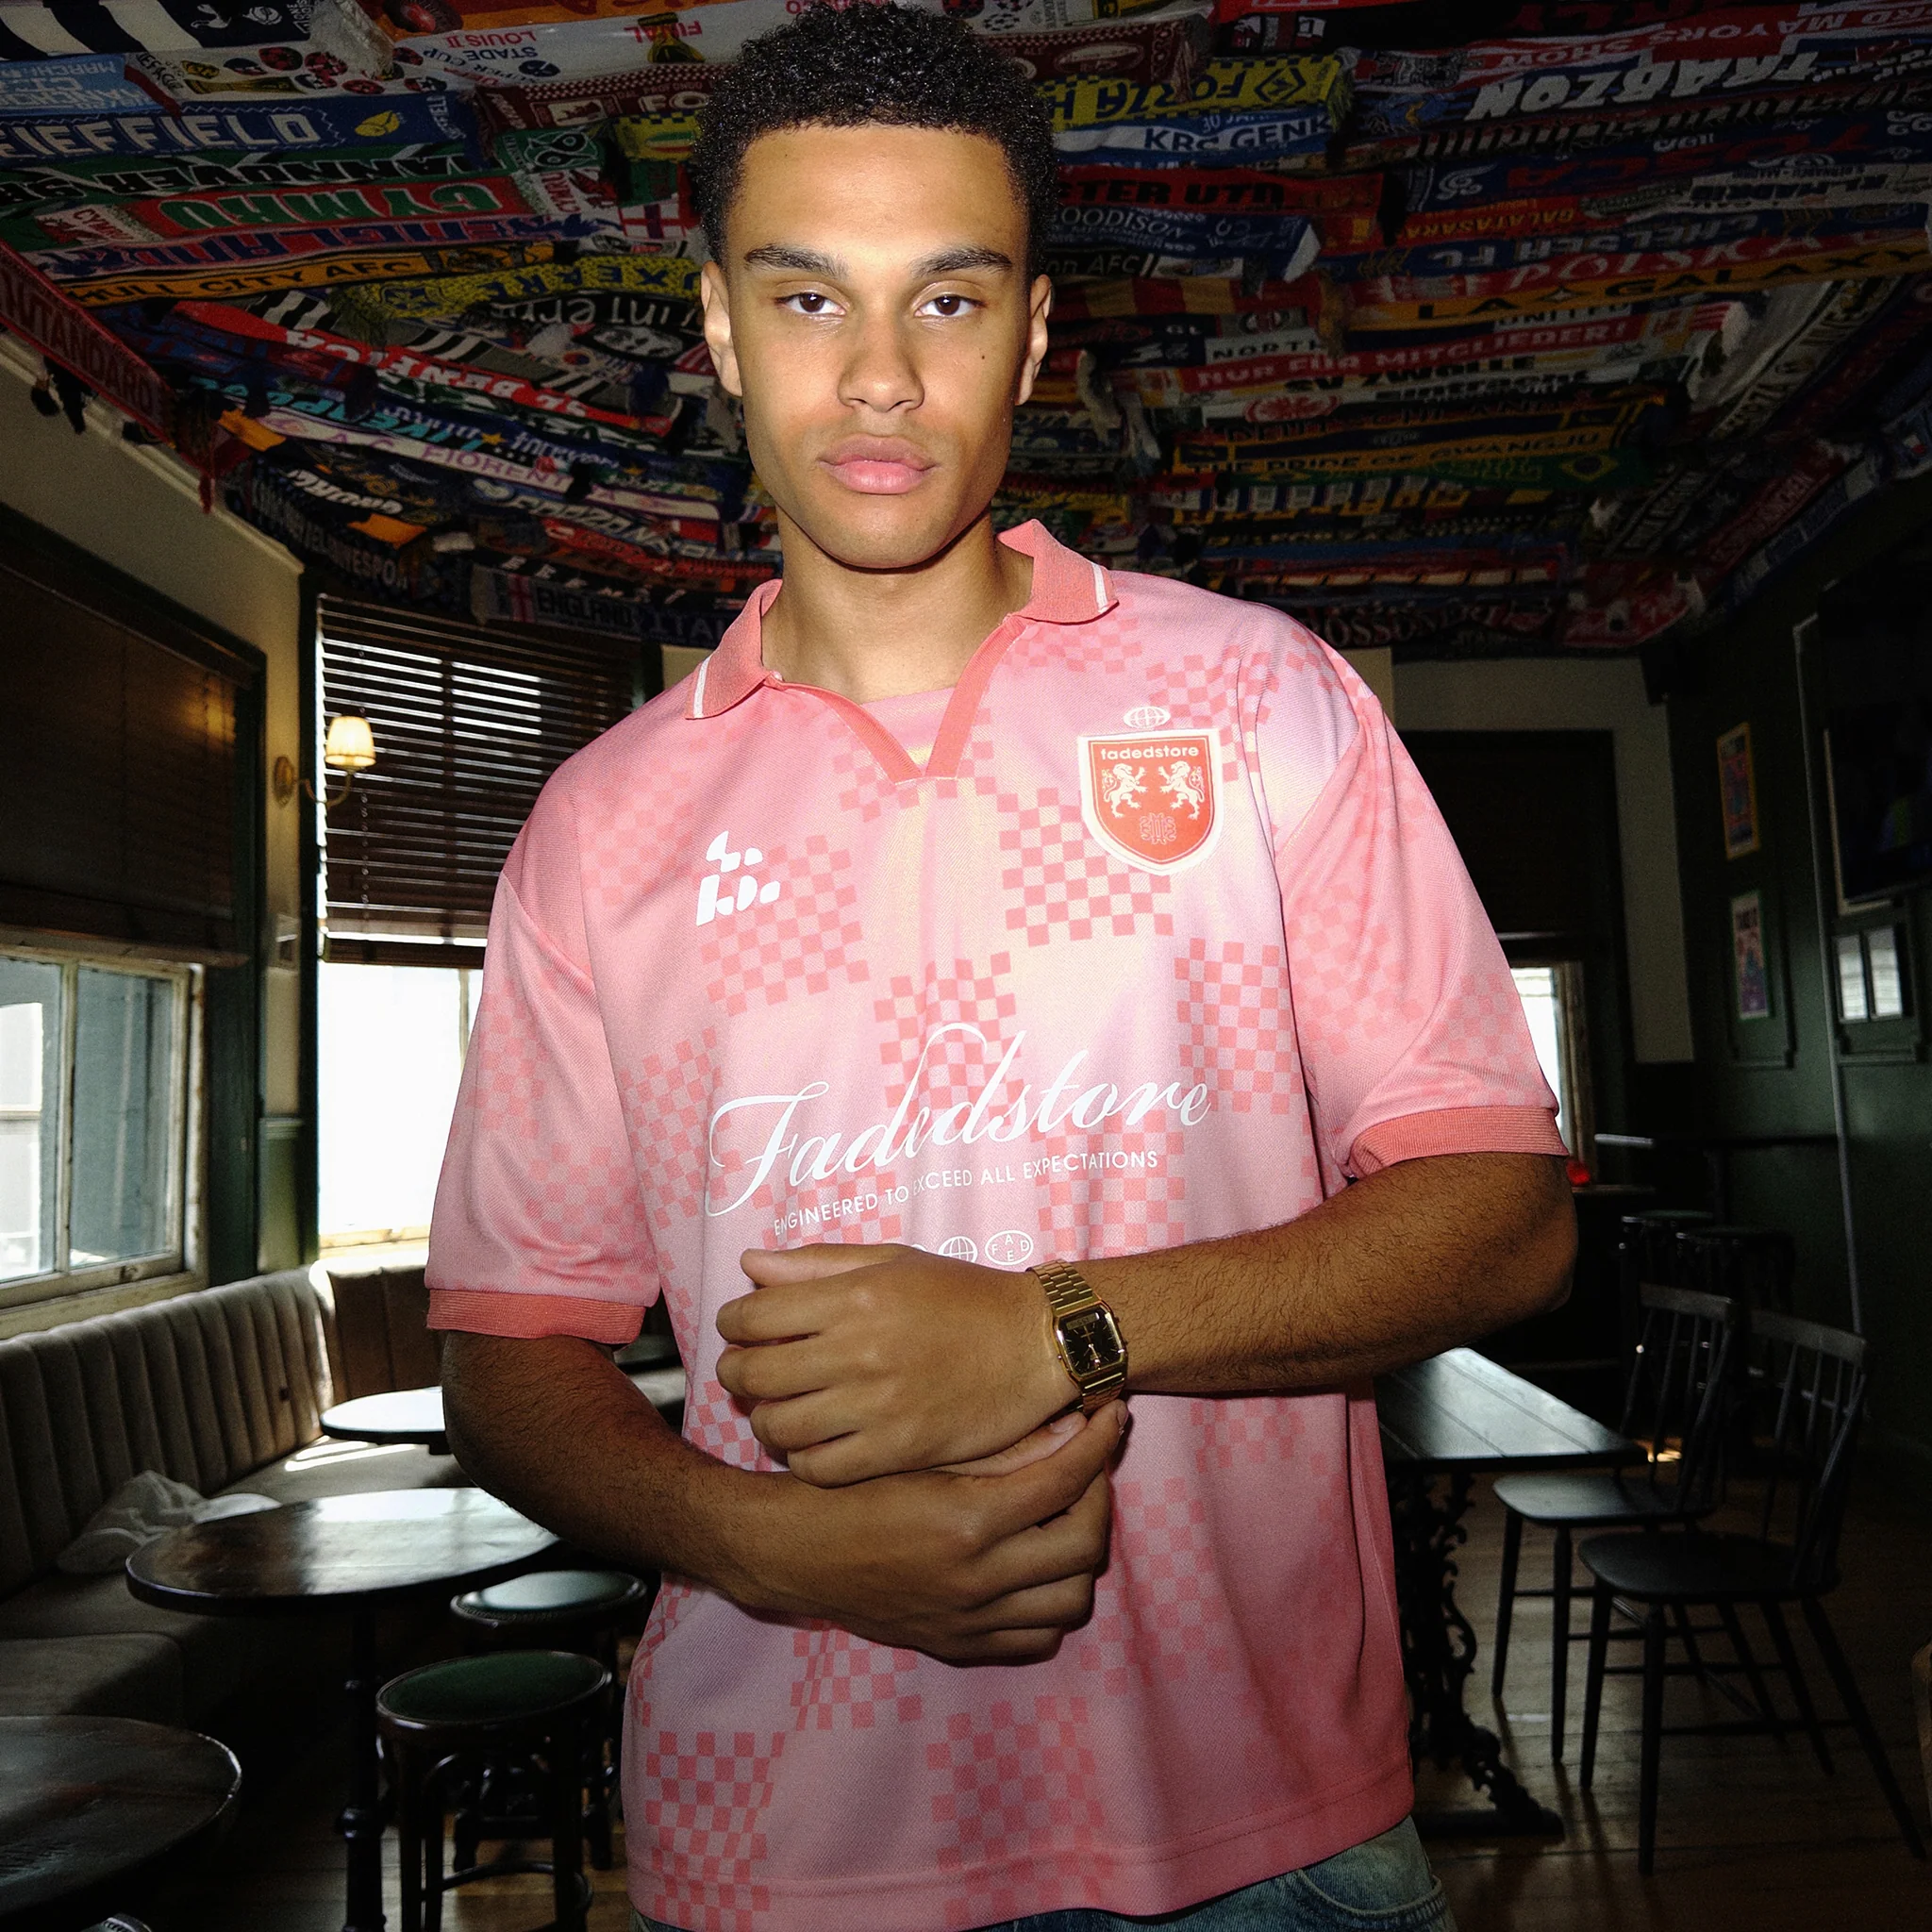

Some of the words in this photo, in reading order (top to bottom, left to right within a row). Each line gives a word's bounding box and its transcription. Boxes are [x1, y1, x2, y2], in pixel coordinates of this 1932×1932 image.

[464, 31, 537, 46] LOUIS
[1649, 13, 1845, 43] MAYORS
[423, 48, 466, 68] CUP
[462, 46, 538, 61] STADE
[1498, 36, 1634, 69] SHOW
[1463, 50, 1820, 121] TRABZON
[1230, 115, 1332, 149] GENK
[158, 182, 503, 230] CYMRU
[1050, 205, 1185, 240] OODISON
[1404, 207, 1574, 238] GALATASARA
[1514, 215, 1759, 261] CHELSEA
[1087, 253, 1141, 276] AFC
[1427, 244, 1496, 268] FC
[1605, 250, 1930, 295] GALAXY
[71, 281, 189, 303] HULL
[195, 270, 306, 296] CITY
[324, 259, 410, 281] AFC
[476, 264, 701, 303] UXERRE
[286, 329, 525, 398] BENFICA
[1100, 744, 1200, 760] fadedstore
[705, 1022, 1212, 1218] Fadedstore
[773, 1192, 878, 1237] ENGINEERED
[885, 1185, 910, 1208] TO
[912, 1173, 973, 1197] EXCEED
[980, 1164, 1016, 1187] ALL
[1023, 1149, 1158, 1179] EXPECTATIONS
